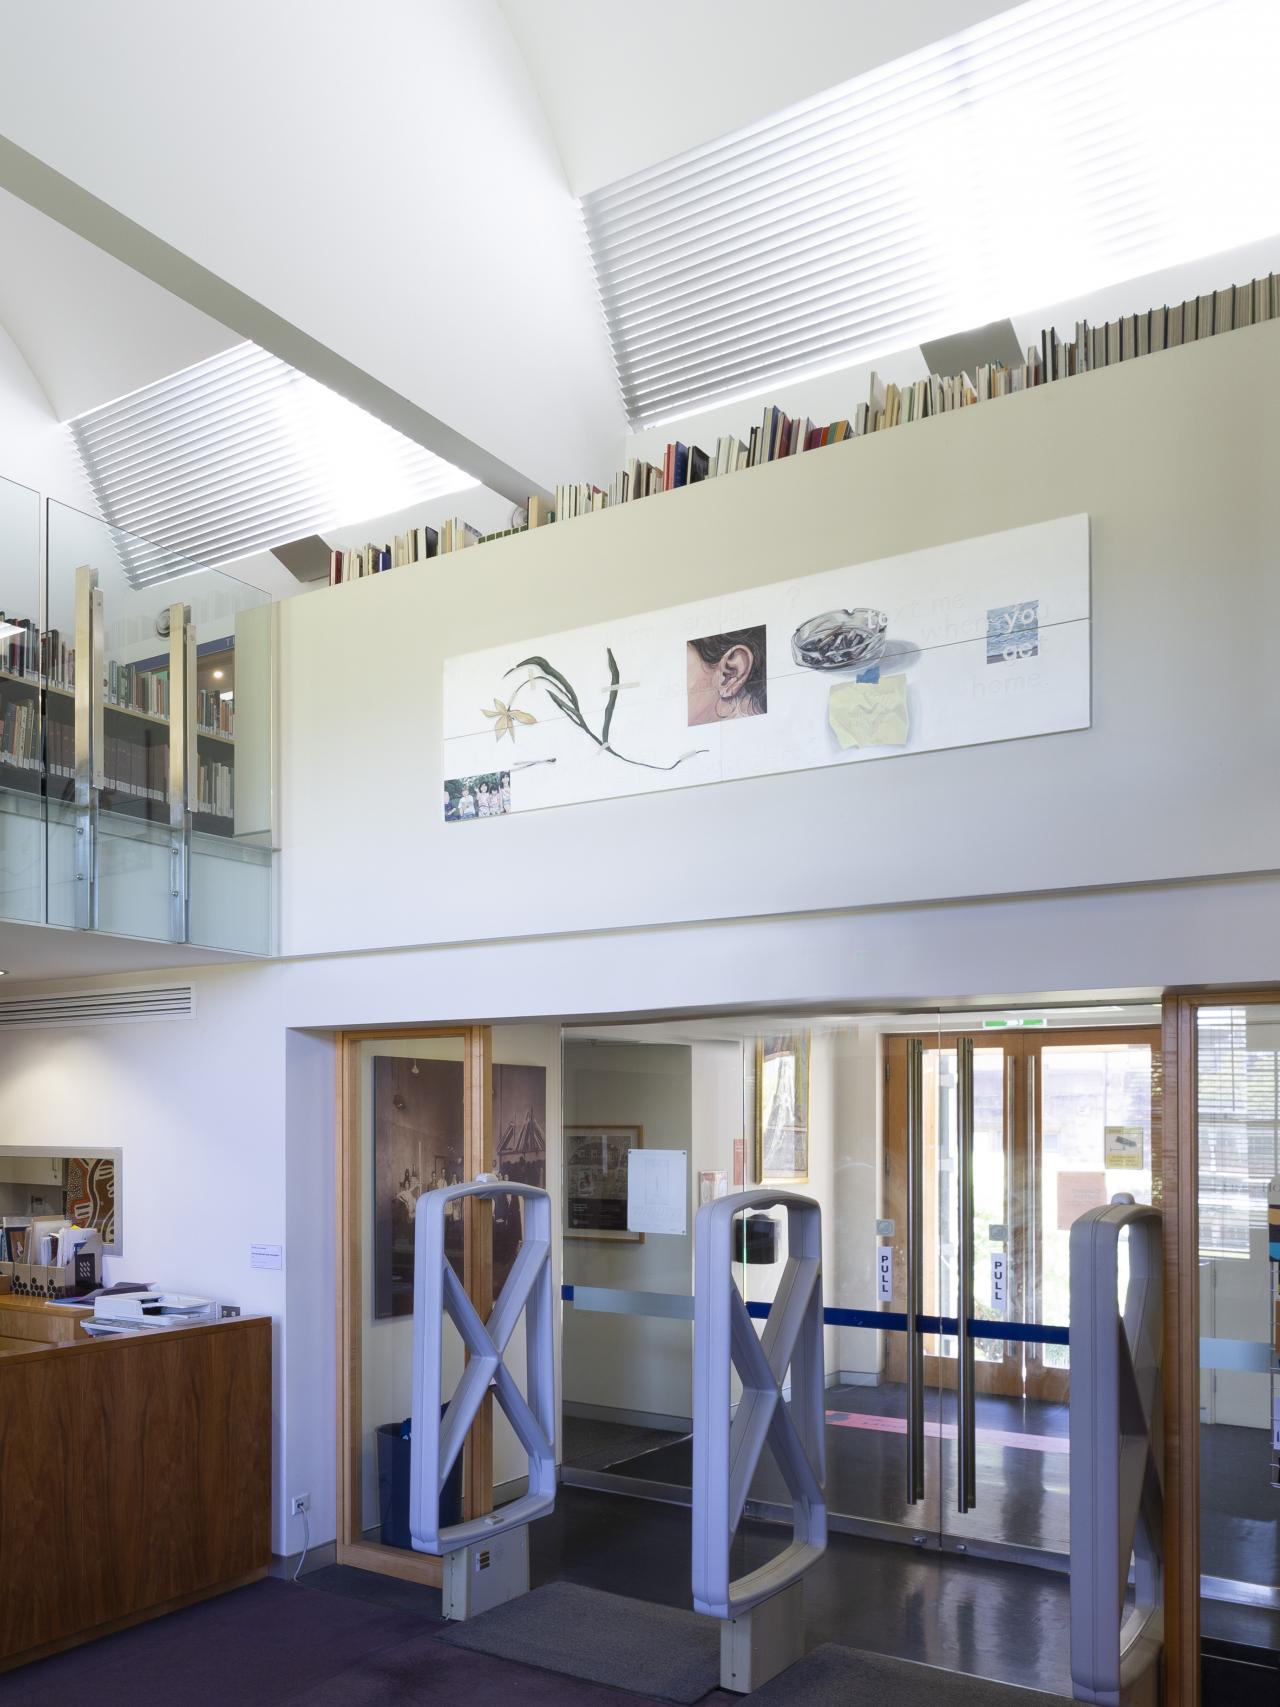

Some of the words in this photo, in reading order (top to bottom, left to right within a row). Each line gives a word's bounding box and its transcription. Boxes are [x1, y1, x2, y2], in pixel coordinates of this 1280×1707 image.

[929, 590, 967, 611] me
[1003, 601, 1050, 635] you
[881, 1255, 889, 1292] PULL
[994, 1261, 1002, 1300] PULL
